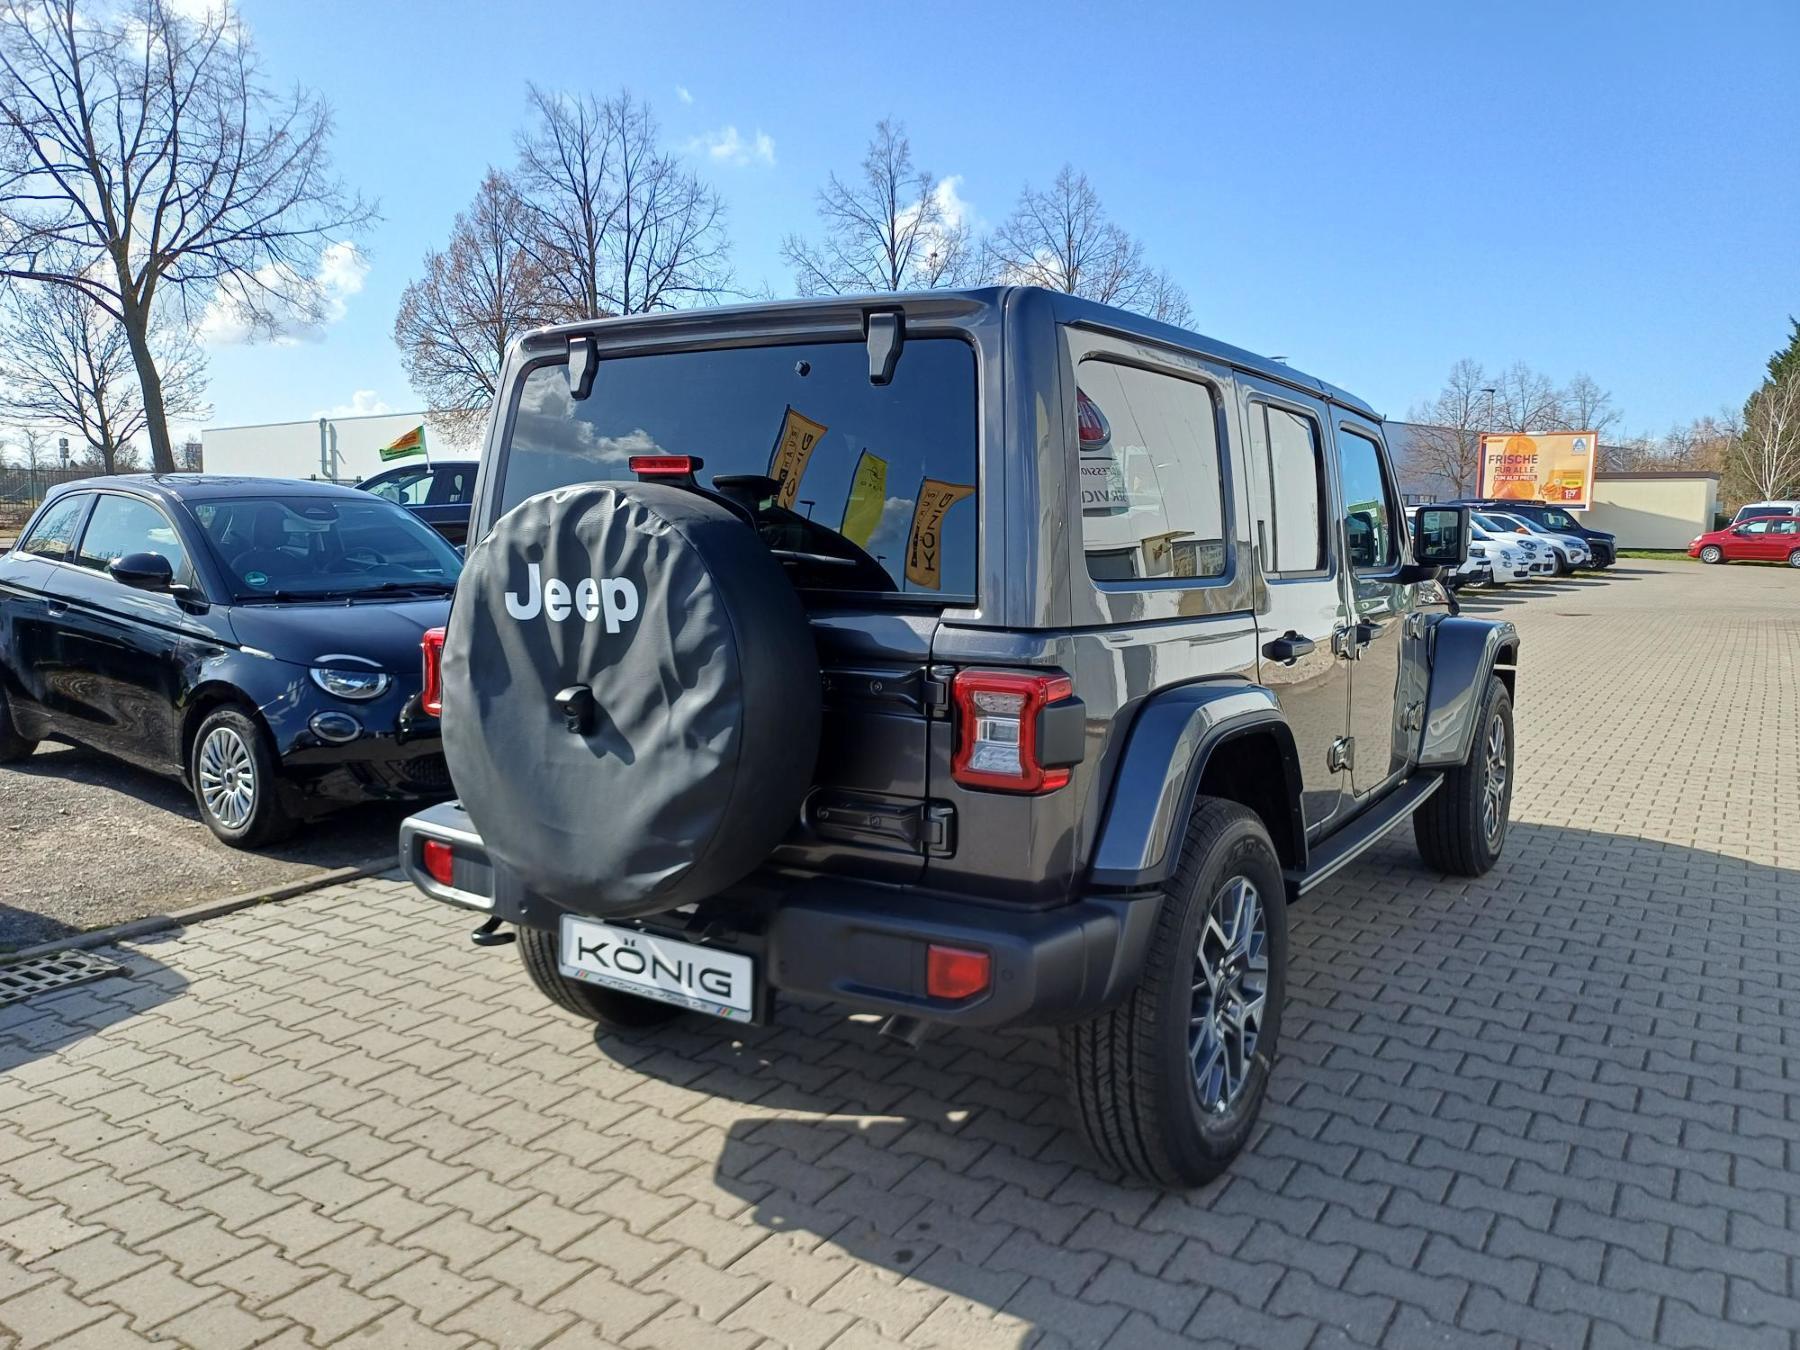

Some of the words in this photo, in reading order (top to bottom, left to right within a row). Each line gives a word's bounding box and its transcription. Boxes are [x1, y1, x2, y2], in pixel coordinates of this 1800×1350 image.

[1488, 454, 1538, 464] FRISCHE
[919, 493, 954, 571] KÖNIG
[504, 563, 639, 633] Jeep
[578, 936, 732, 998] KÖNIG
